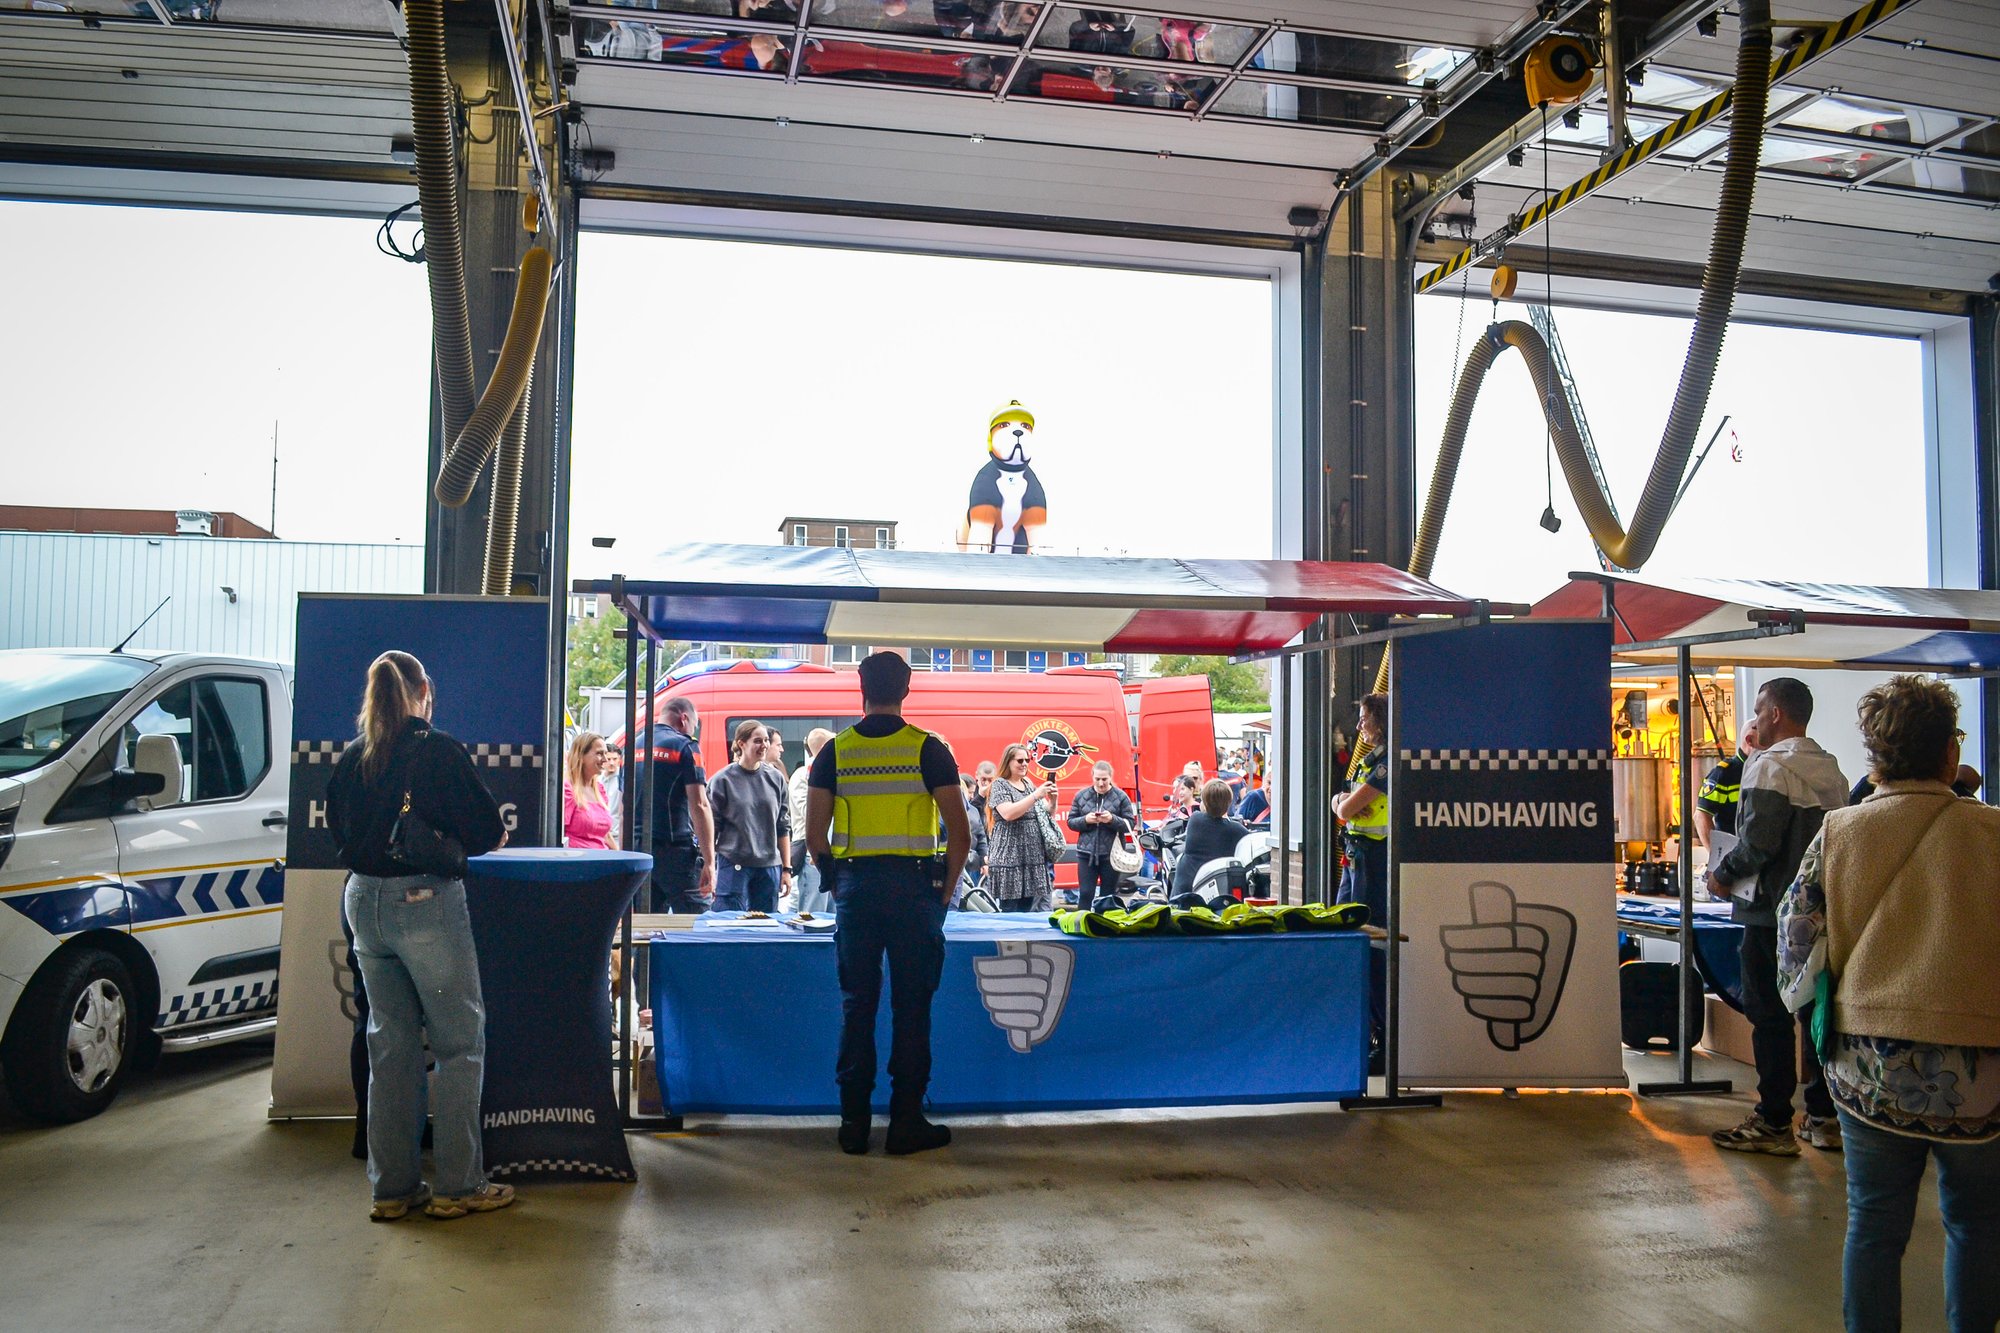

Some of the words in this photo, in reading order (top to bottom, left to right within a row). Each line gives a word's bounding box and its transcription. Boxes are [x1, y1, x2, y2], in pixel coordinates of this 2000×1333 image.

[1026, 720, 1077, 743] DUIKTEAM
[1035, 767, 1067, 779] VRW
[1414, 801, 1598, 828] HANDHAVING
[483, 1107, 595, 1129] HANDHAVING
